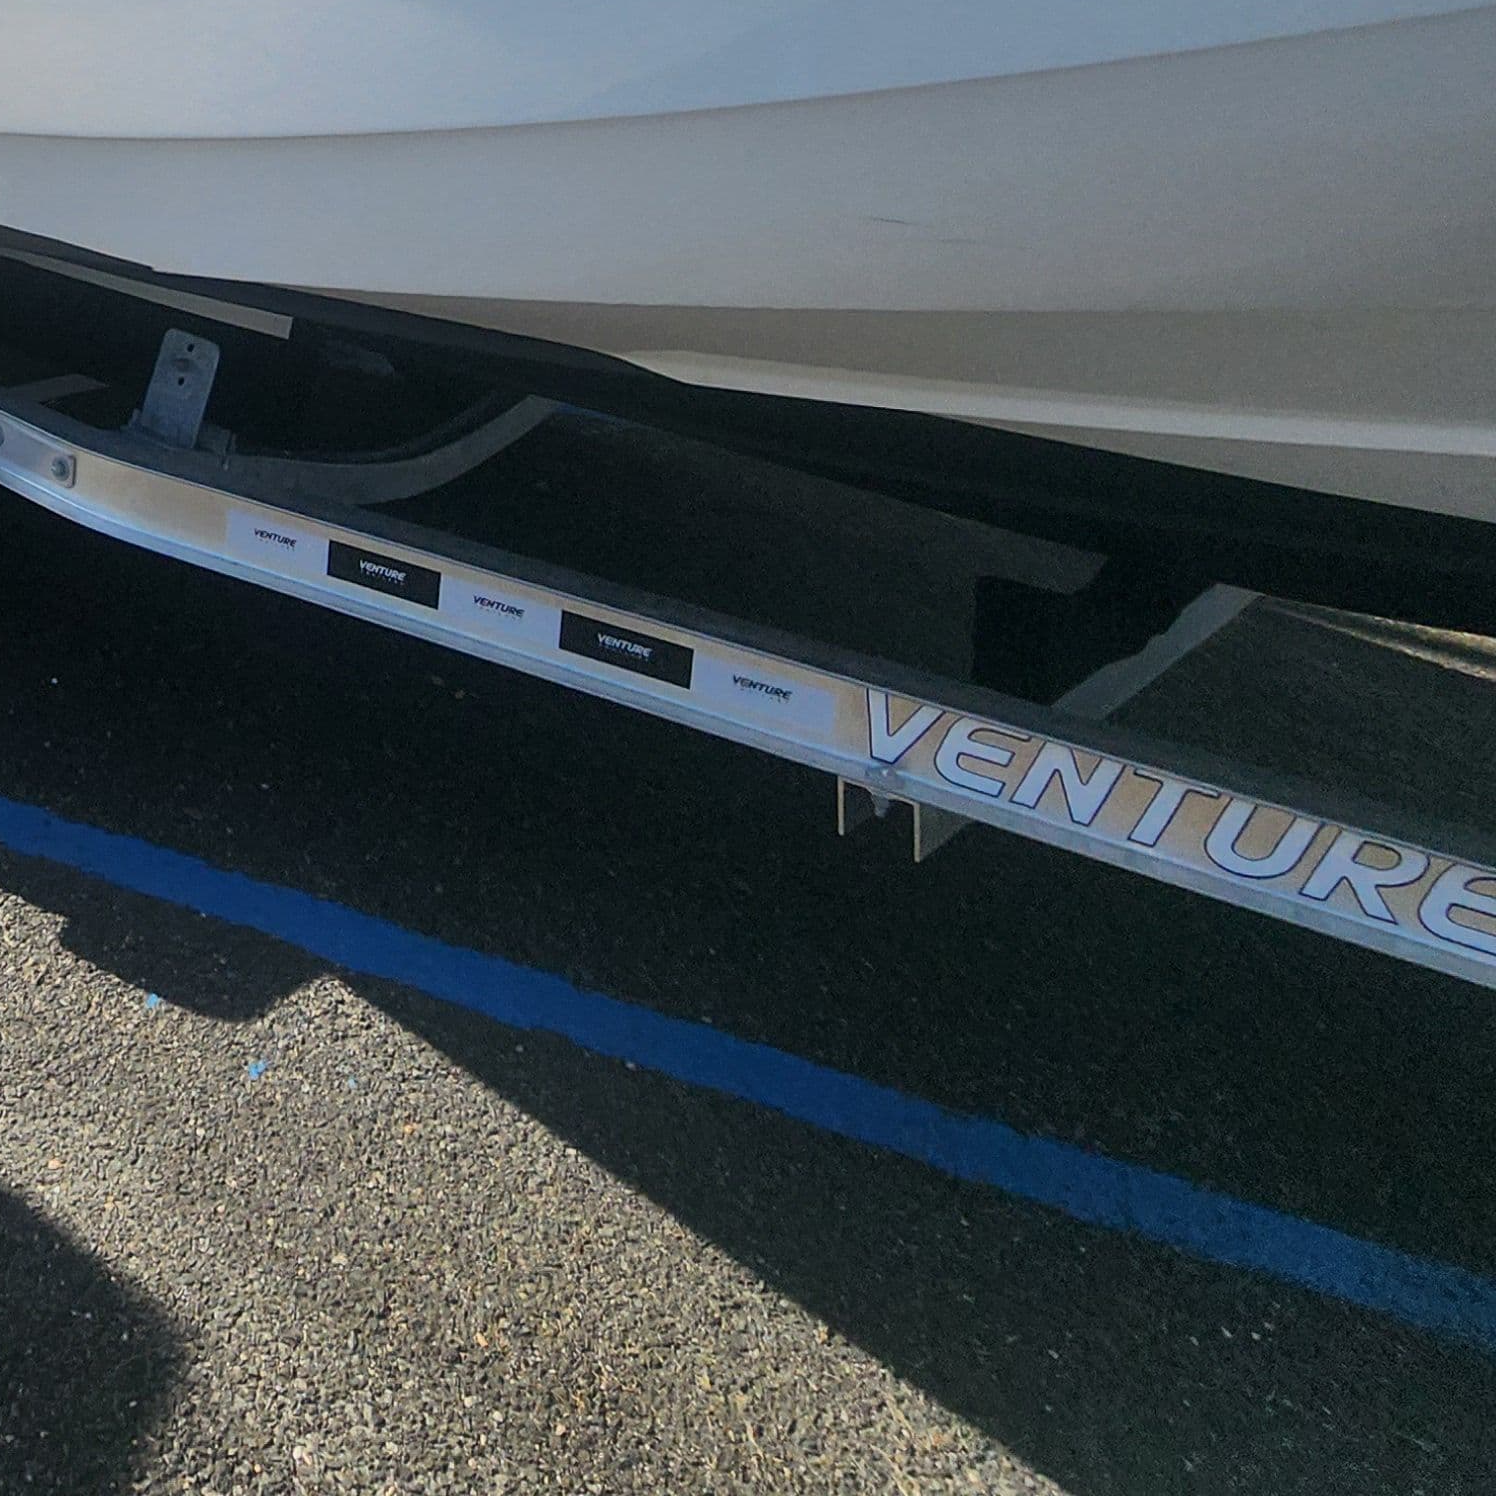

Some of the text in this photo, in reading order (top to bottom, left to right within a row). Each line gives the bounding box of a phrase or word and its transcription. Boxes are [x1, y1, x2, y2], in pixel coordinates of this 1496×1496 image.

[254, 528, 297, 548] VENTURE
[359, 559, 407, 582] VENTURE
[473, 595, 526, 618] VENTURE
[596, 632, 654, 658] VENTURE
[732, 674, 793, 700] VENTURE
[865, 687, 1496, 958] VENTURE
